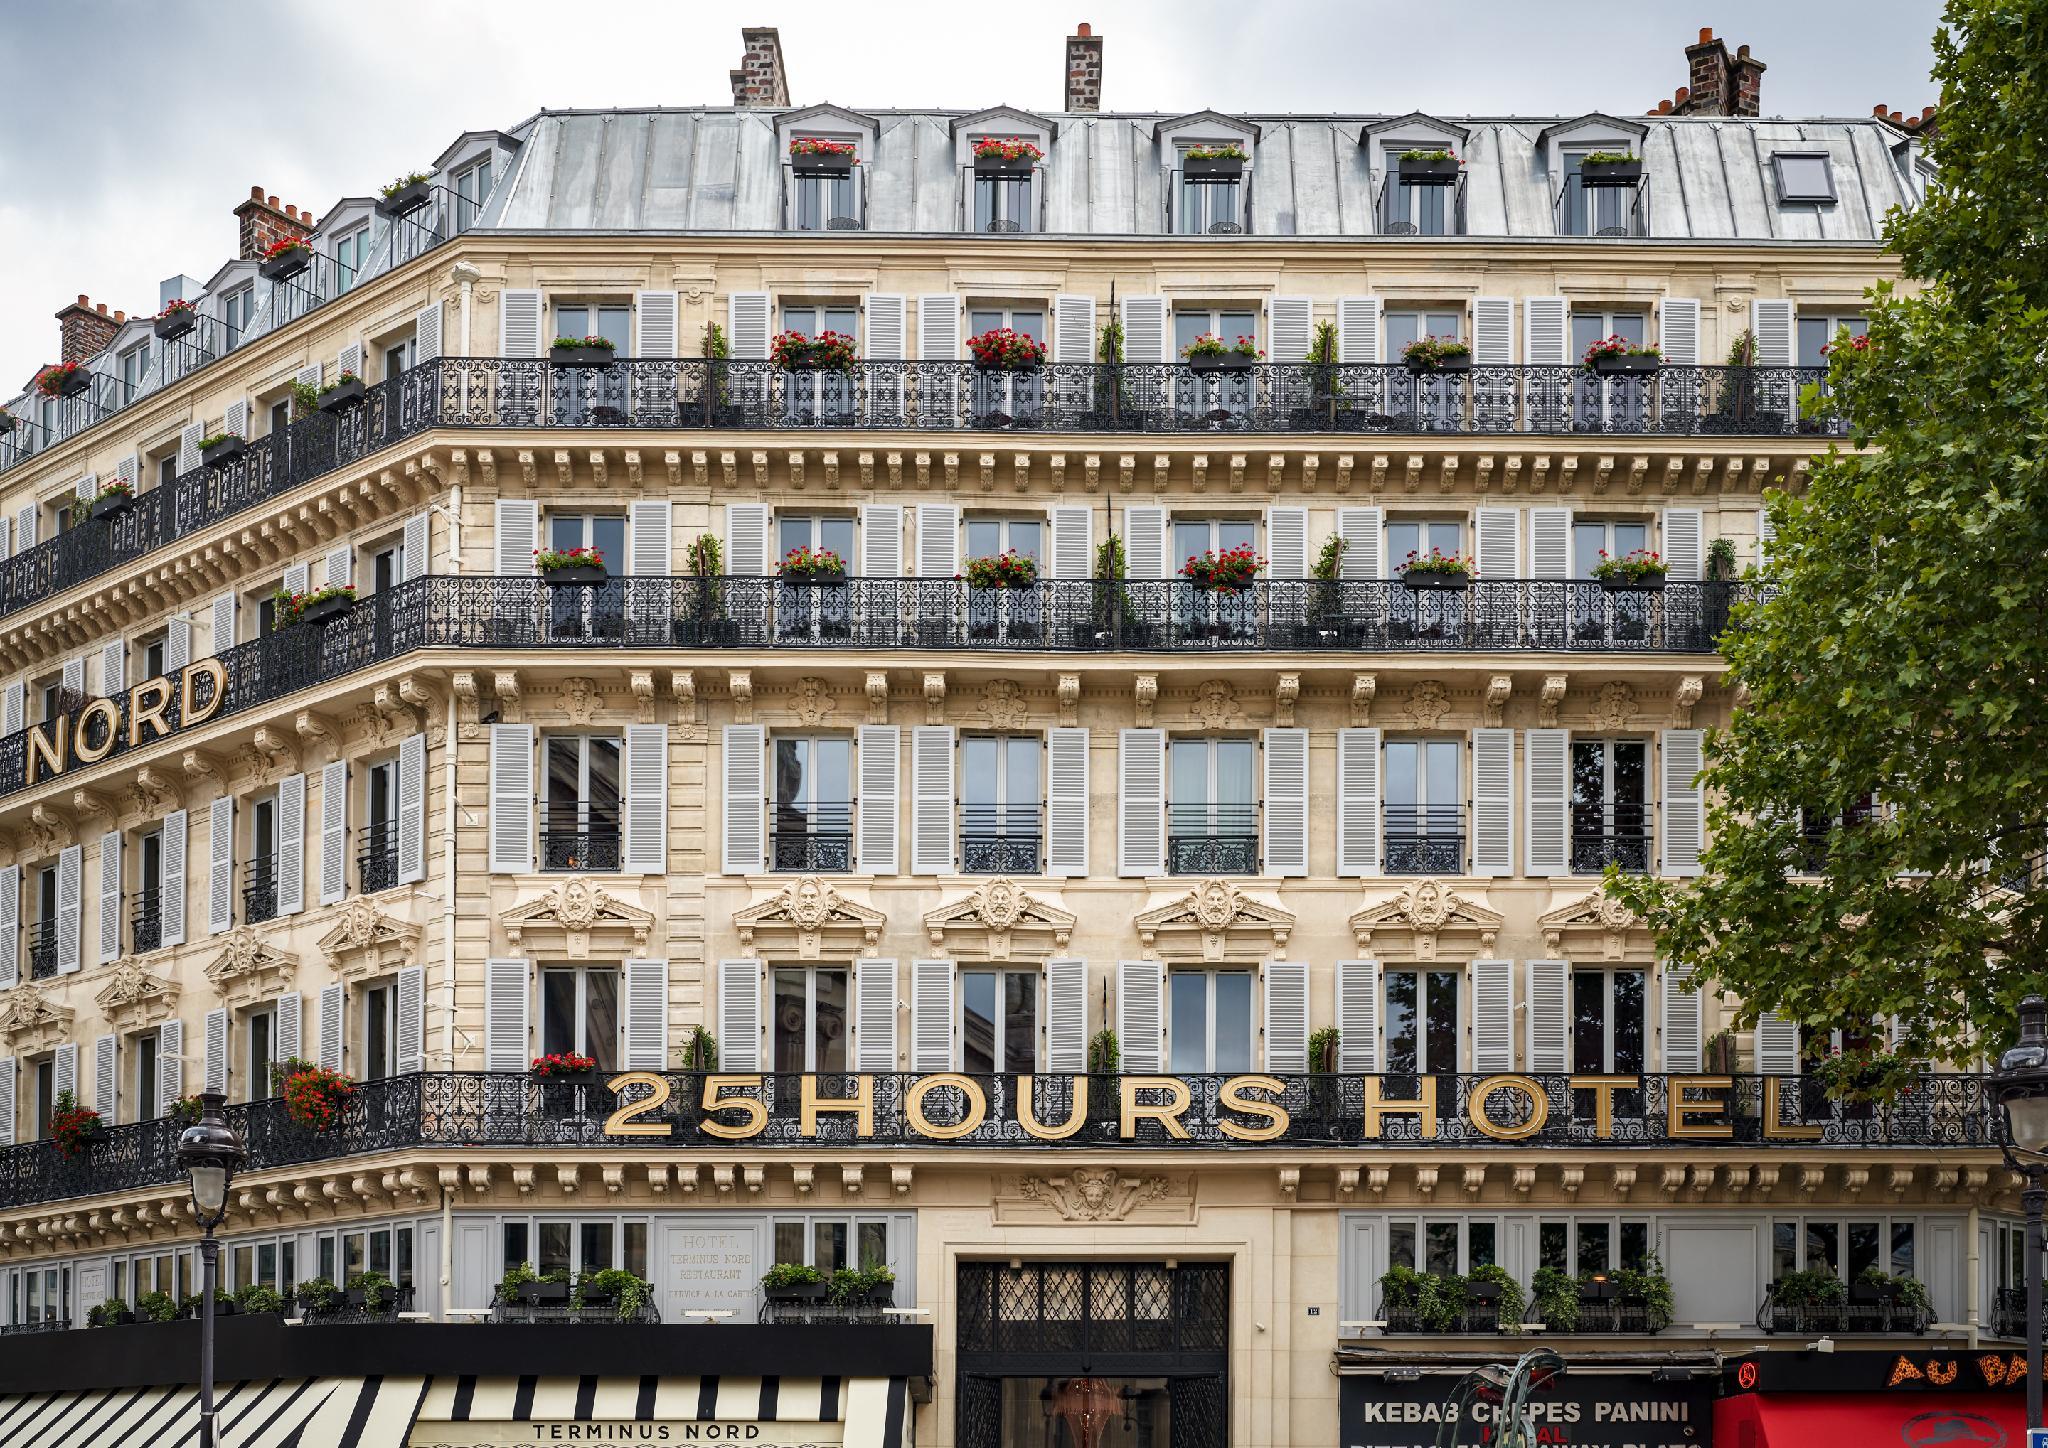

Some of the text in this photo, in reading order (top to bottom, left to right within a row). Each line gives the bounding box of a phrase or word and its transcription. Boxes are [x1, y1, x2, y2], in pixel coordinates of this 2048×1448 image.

[26, 657, 228, 785] NORD
[1364, 1075, 1823, 1140] HOTEL
[680, 1269, 742, 1280] RESTAURANT
[1888, 1352, 2048, 1387] AU BA
[1364, 1402, 1459, 1423] KEBAB
[1595, 1401, 1688, 1422] PANINI
[533, 1424, 760, 1439] TERMINUS NORD
